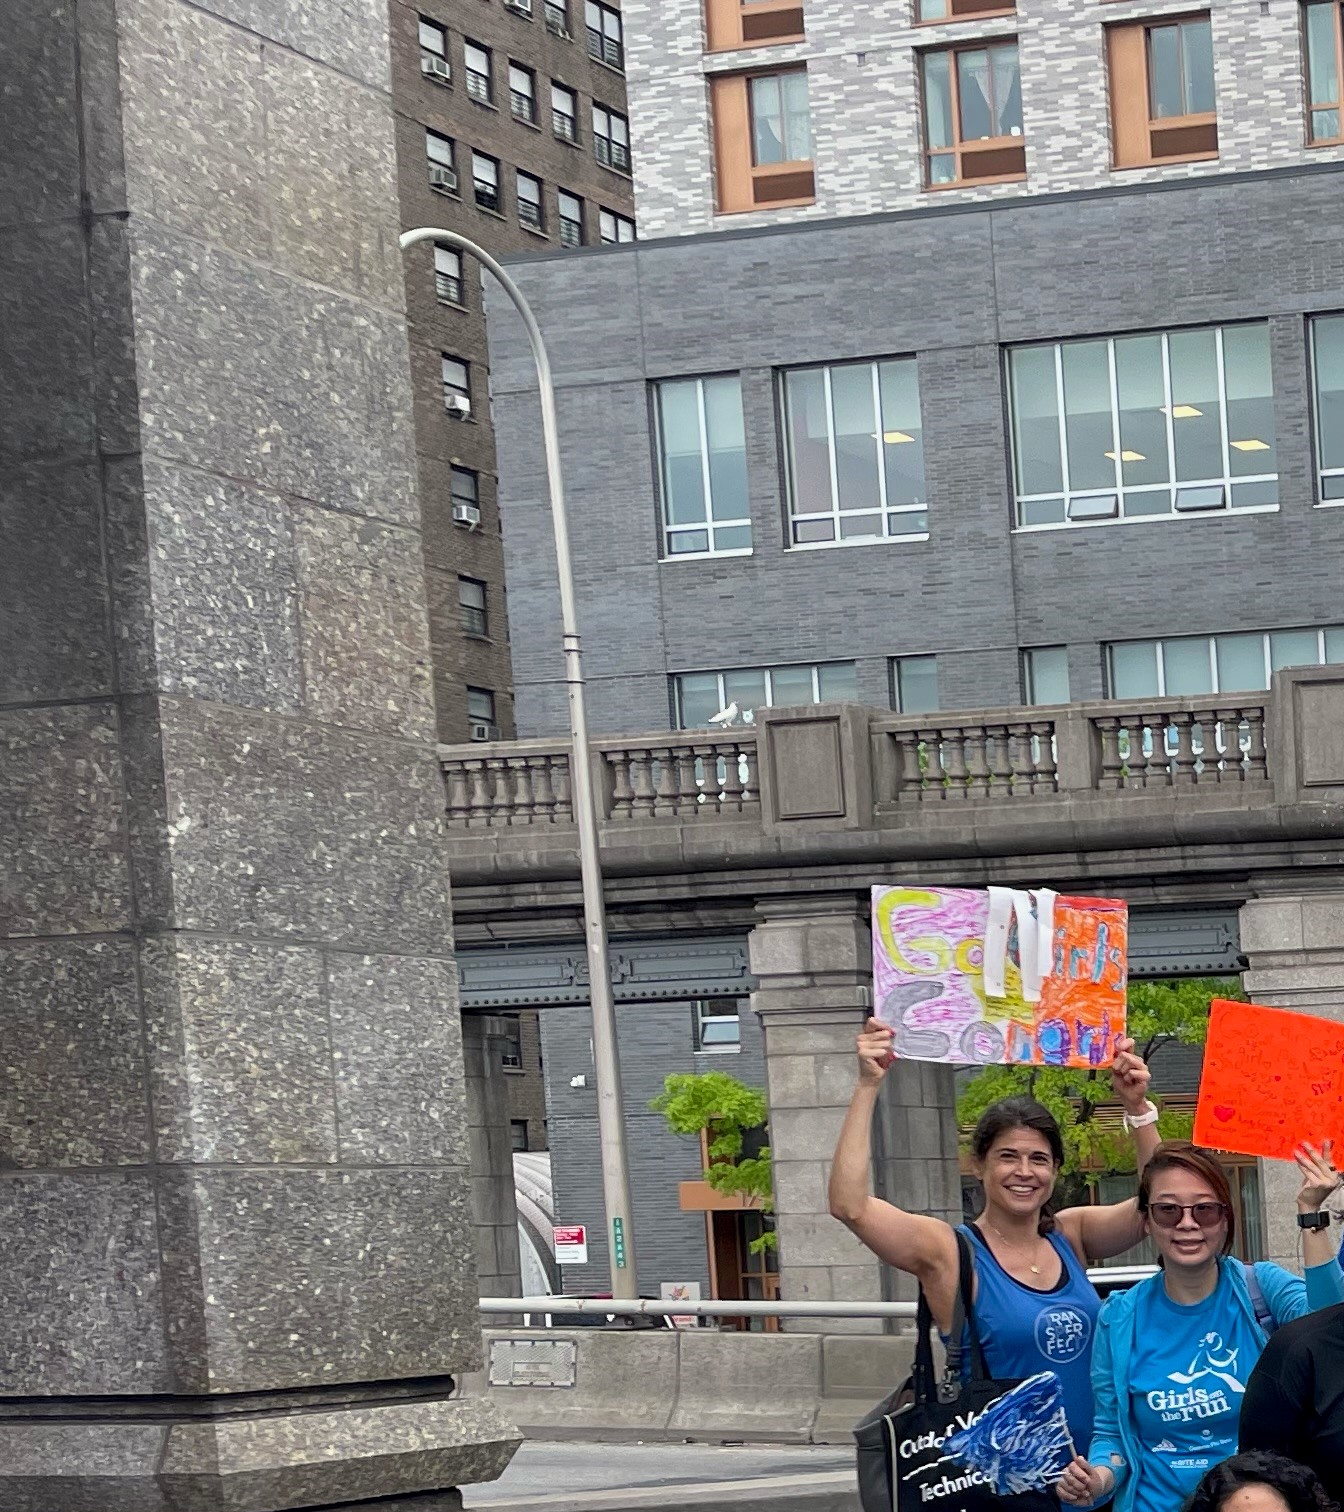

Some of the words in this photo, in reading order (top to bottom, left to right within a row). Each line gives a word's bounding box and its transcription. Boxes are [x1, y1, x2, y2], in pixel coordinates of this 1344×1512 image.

[1147, 1387, 1209, 1411] Girls
[1161, 1412, 1181, 1422] the
[1179, 1397, 1231, 1422] run
